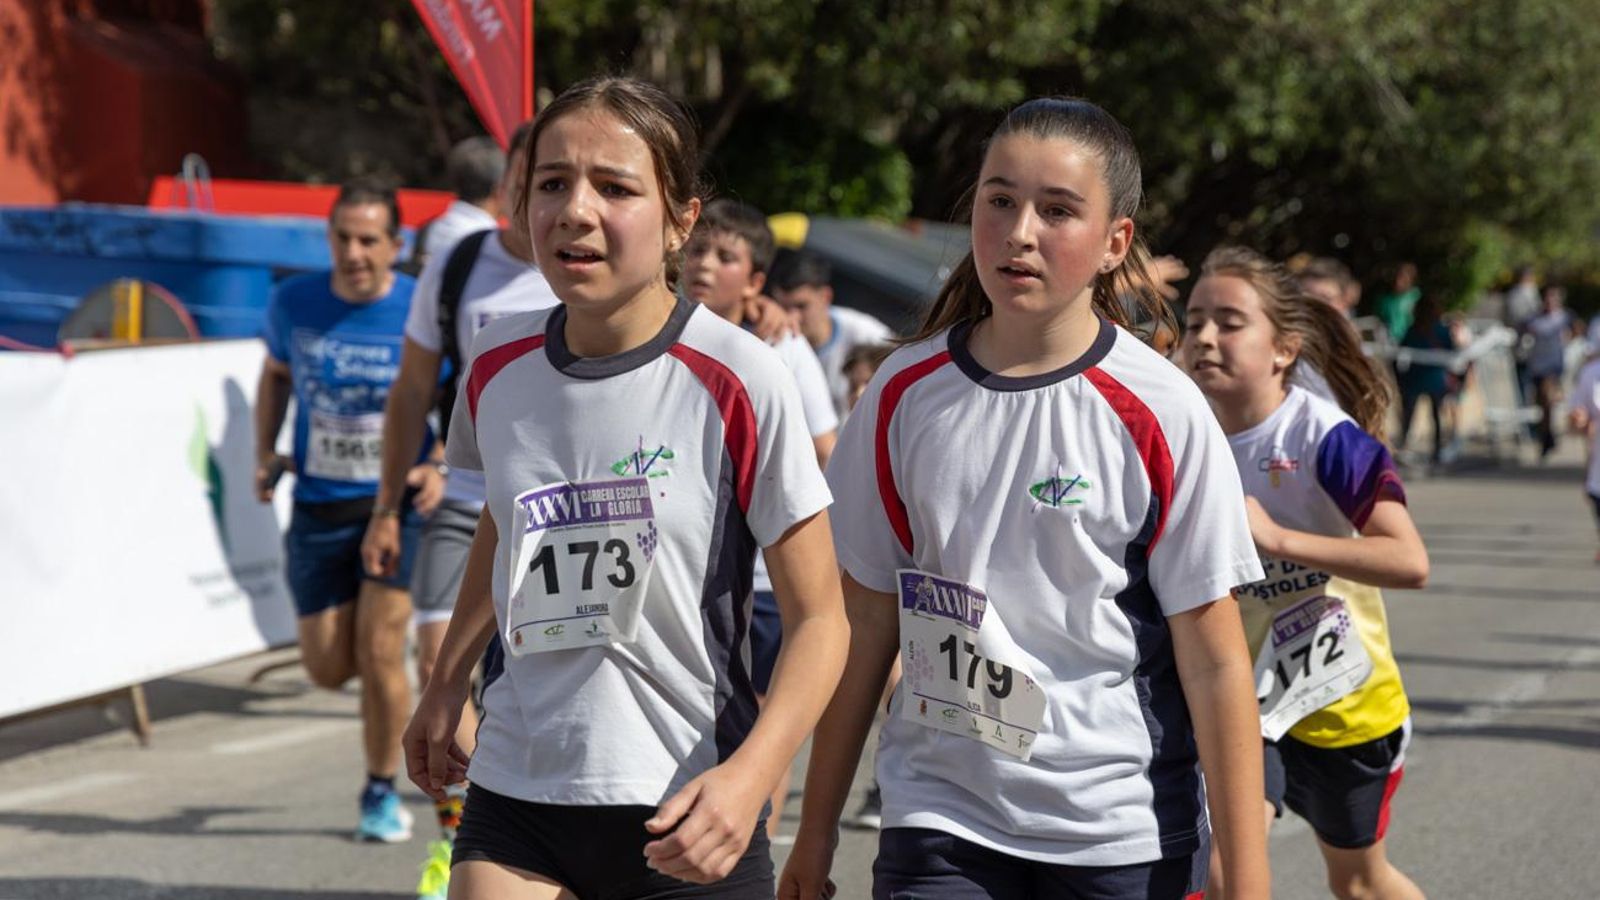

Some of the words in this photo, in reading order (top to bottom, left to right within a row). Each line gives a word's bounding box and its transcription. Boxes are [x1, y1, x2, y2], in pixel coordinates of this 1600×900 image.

[581, 488, 615, 503] CARRERA
[615, 485, 650, 500] ESCOLAR
[590, 502, 601, 518] LA
[608, 500, 642, 516] GLORIA
[529, 538, 636, 595] 173
[939, 634, 1013, 699] 179
[1275, 631, 1345, 691] 172
